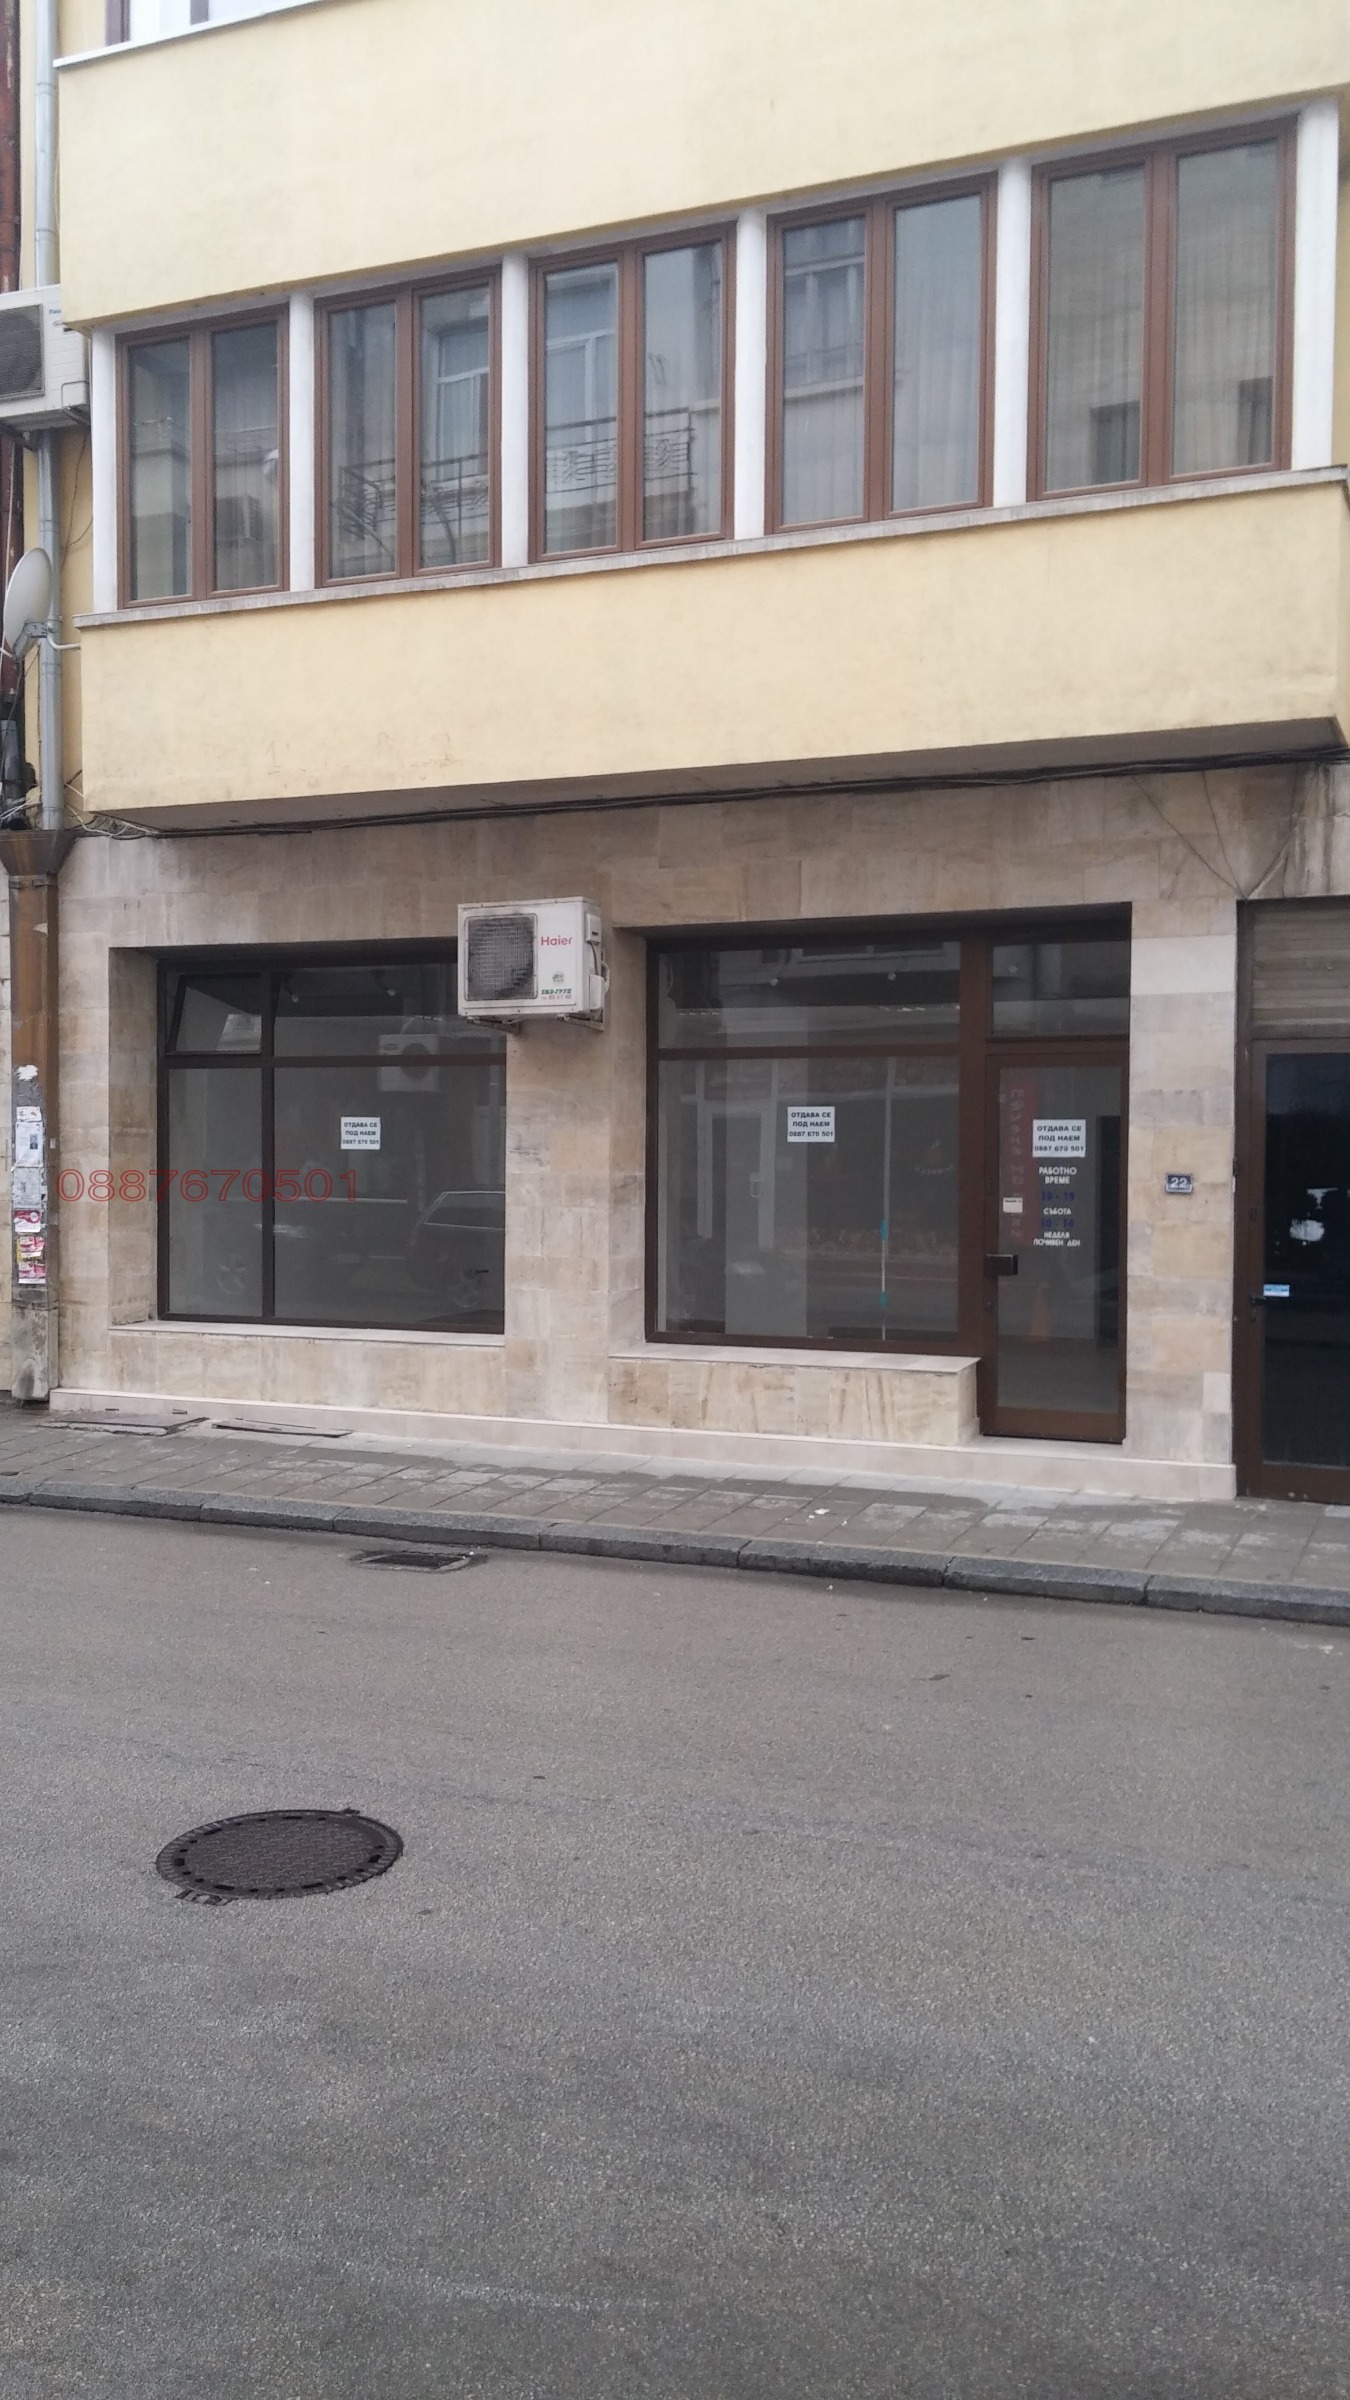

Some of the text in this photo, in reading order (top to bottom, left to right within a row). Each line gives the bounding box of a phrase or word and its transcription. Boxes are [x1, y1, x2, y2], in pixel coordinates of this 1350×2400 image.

[541, 935, 572, 946] Haier
[1038, 1166, 1078, 1176] РАБОТНО
[1044, 1175, 1071, 1185] ВРЕМЕ
[1170, 1177, 1188, 1189] 22
[1064, 1191, 1075, 1201] 19
[1043, 1207, 1072, 1215] СЪБОТА
[1041, 1218, 1053, 1228] 10
[1043, 1231, 1070, 1239] НЕДЕЛЯ
[1033, 1238, 1081, 1247] ПОЧИВЕН ДЕН
